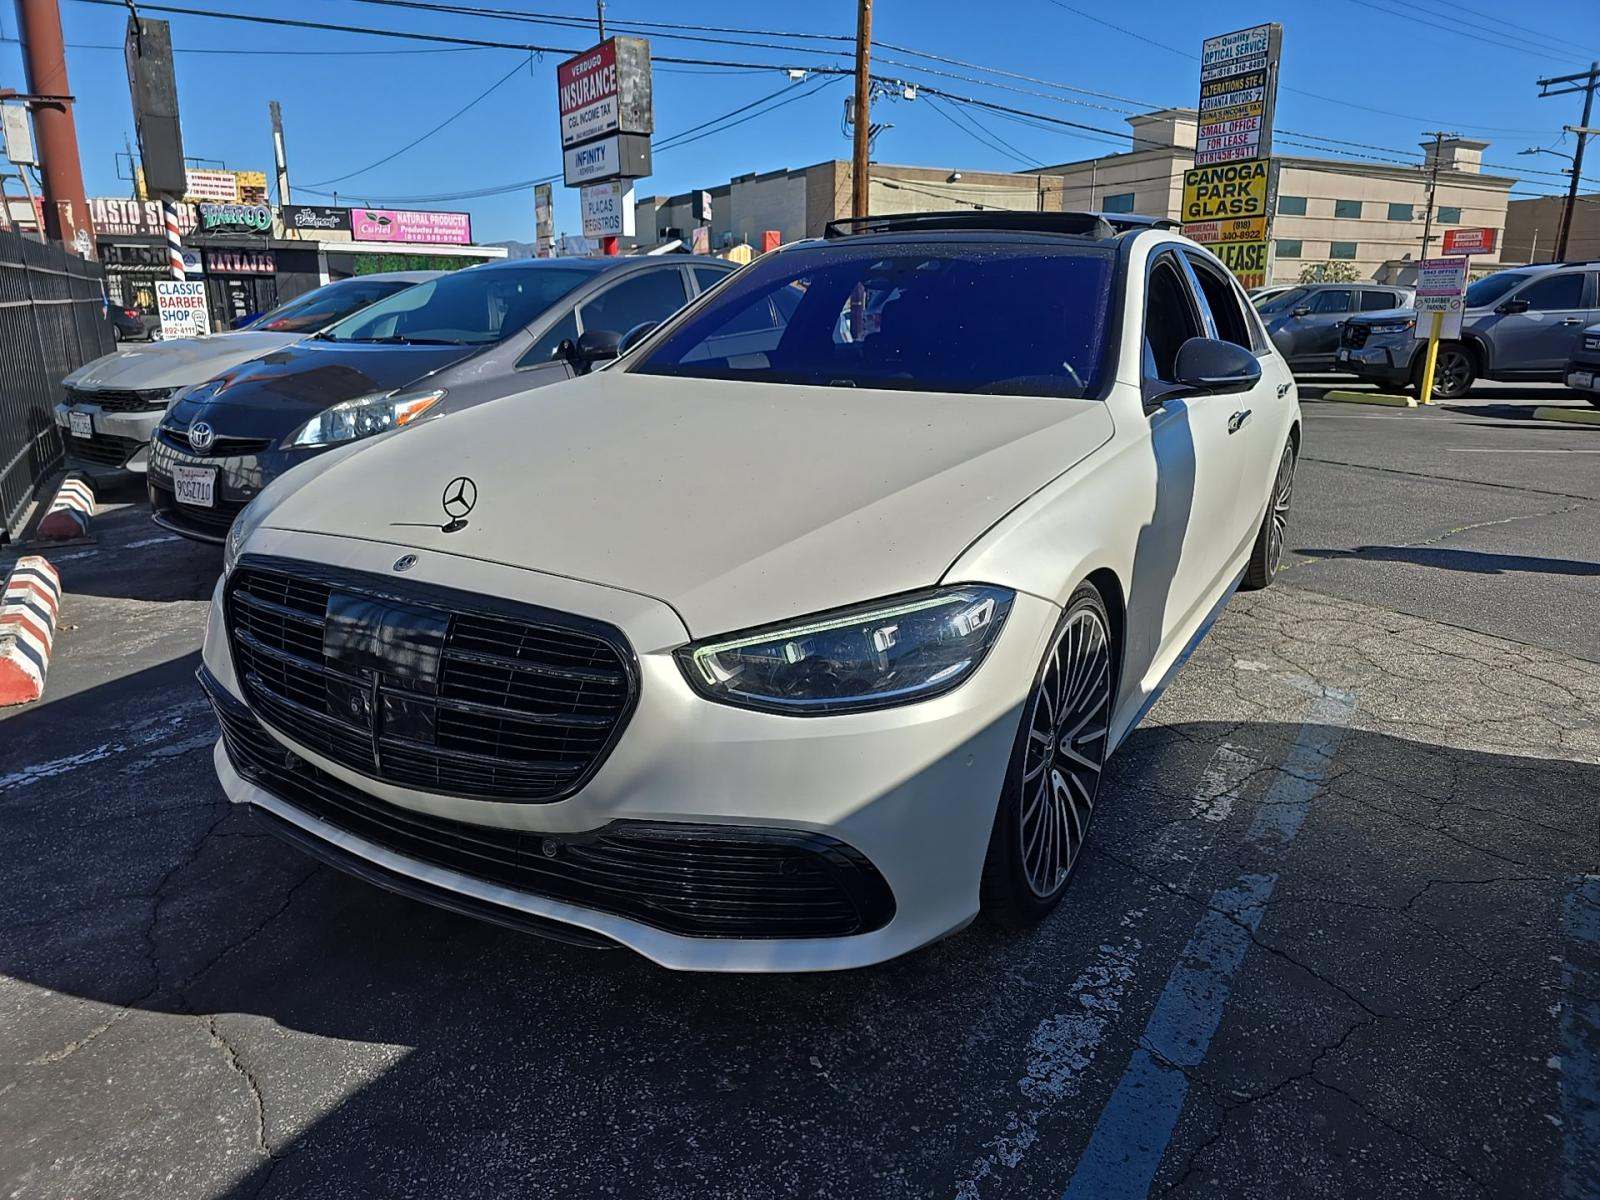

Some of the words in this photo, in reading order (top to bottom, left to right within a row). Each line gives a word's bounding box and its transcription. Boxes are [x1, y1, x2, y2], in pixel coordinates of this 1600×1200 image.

[1221, 32, 1250, 46] Quality
[1204, 48, 1233, 63] OPTICAL
[1236, 39, 1267, 56] SERVICE
[571, 54, 602, 76] VERDUGO
[561, 64, 617, 112] INSURANCE
[1202, 79, 1244, 96] ALTERATIONS
[1245, 76, 1258, 88] STE
[1258, 74, 1264, 84] 4
[1229, 91, 1253, 104] MOTORS
[580, 107, 600, 123] INCOME
[600, 102, 611, 117] TAX
[1223, 107, 1249, 117] INCOME
[1249, 103, 1263, 112] TAX
[1201, 123, 1227, 137] SMALL
[1229, 118, 1257, 131] OFFICE
[1207, 136, 1222, 149] FOR
[1224, 133, 1249, 146] LEASE
[576, 145, 606, 167] INFINITY
[1186, 163, 1266, 187] CANOGA
[1196, 182, 1252, 201] PARK
[144, 201, 199, 228] STRE
[301, 208, 316, 219] The
[588, 199, 614, 214] PLACAS
[1188, 198, 1259, 218] GLASS
[397, 212, 429, 225] NATURAL
[430, 215, 466, 227] PRODUCTS
[584, 216, 620, 232] REGISTROS
[1184, 222, 1218, 234] COMMERCIAL
[1232, 220, 1251, 231] (818)
[401, 226, 432, 235] Productos
[208, 253, 274, 272] TATUAJES
[1216, 244, 1266, 271] LEASE
[158, 283, 203, 295] CLASSIC
[160, 297, 204, 308] BARBER
[162, 310, 190, 321] SHOP
[165, 327, 195, 335] 892-4111
